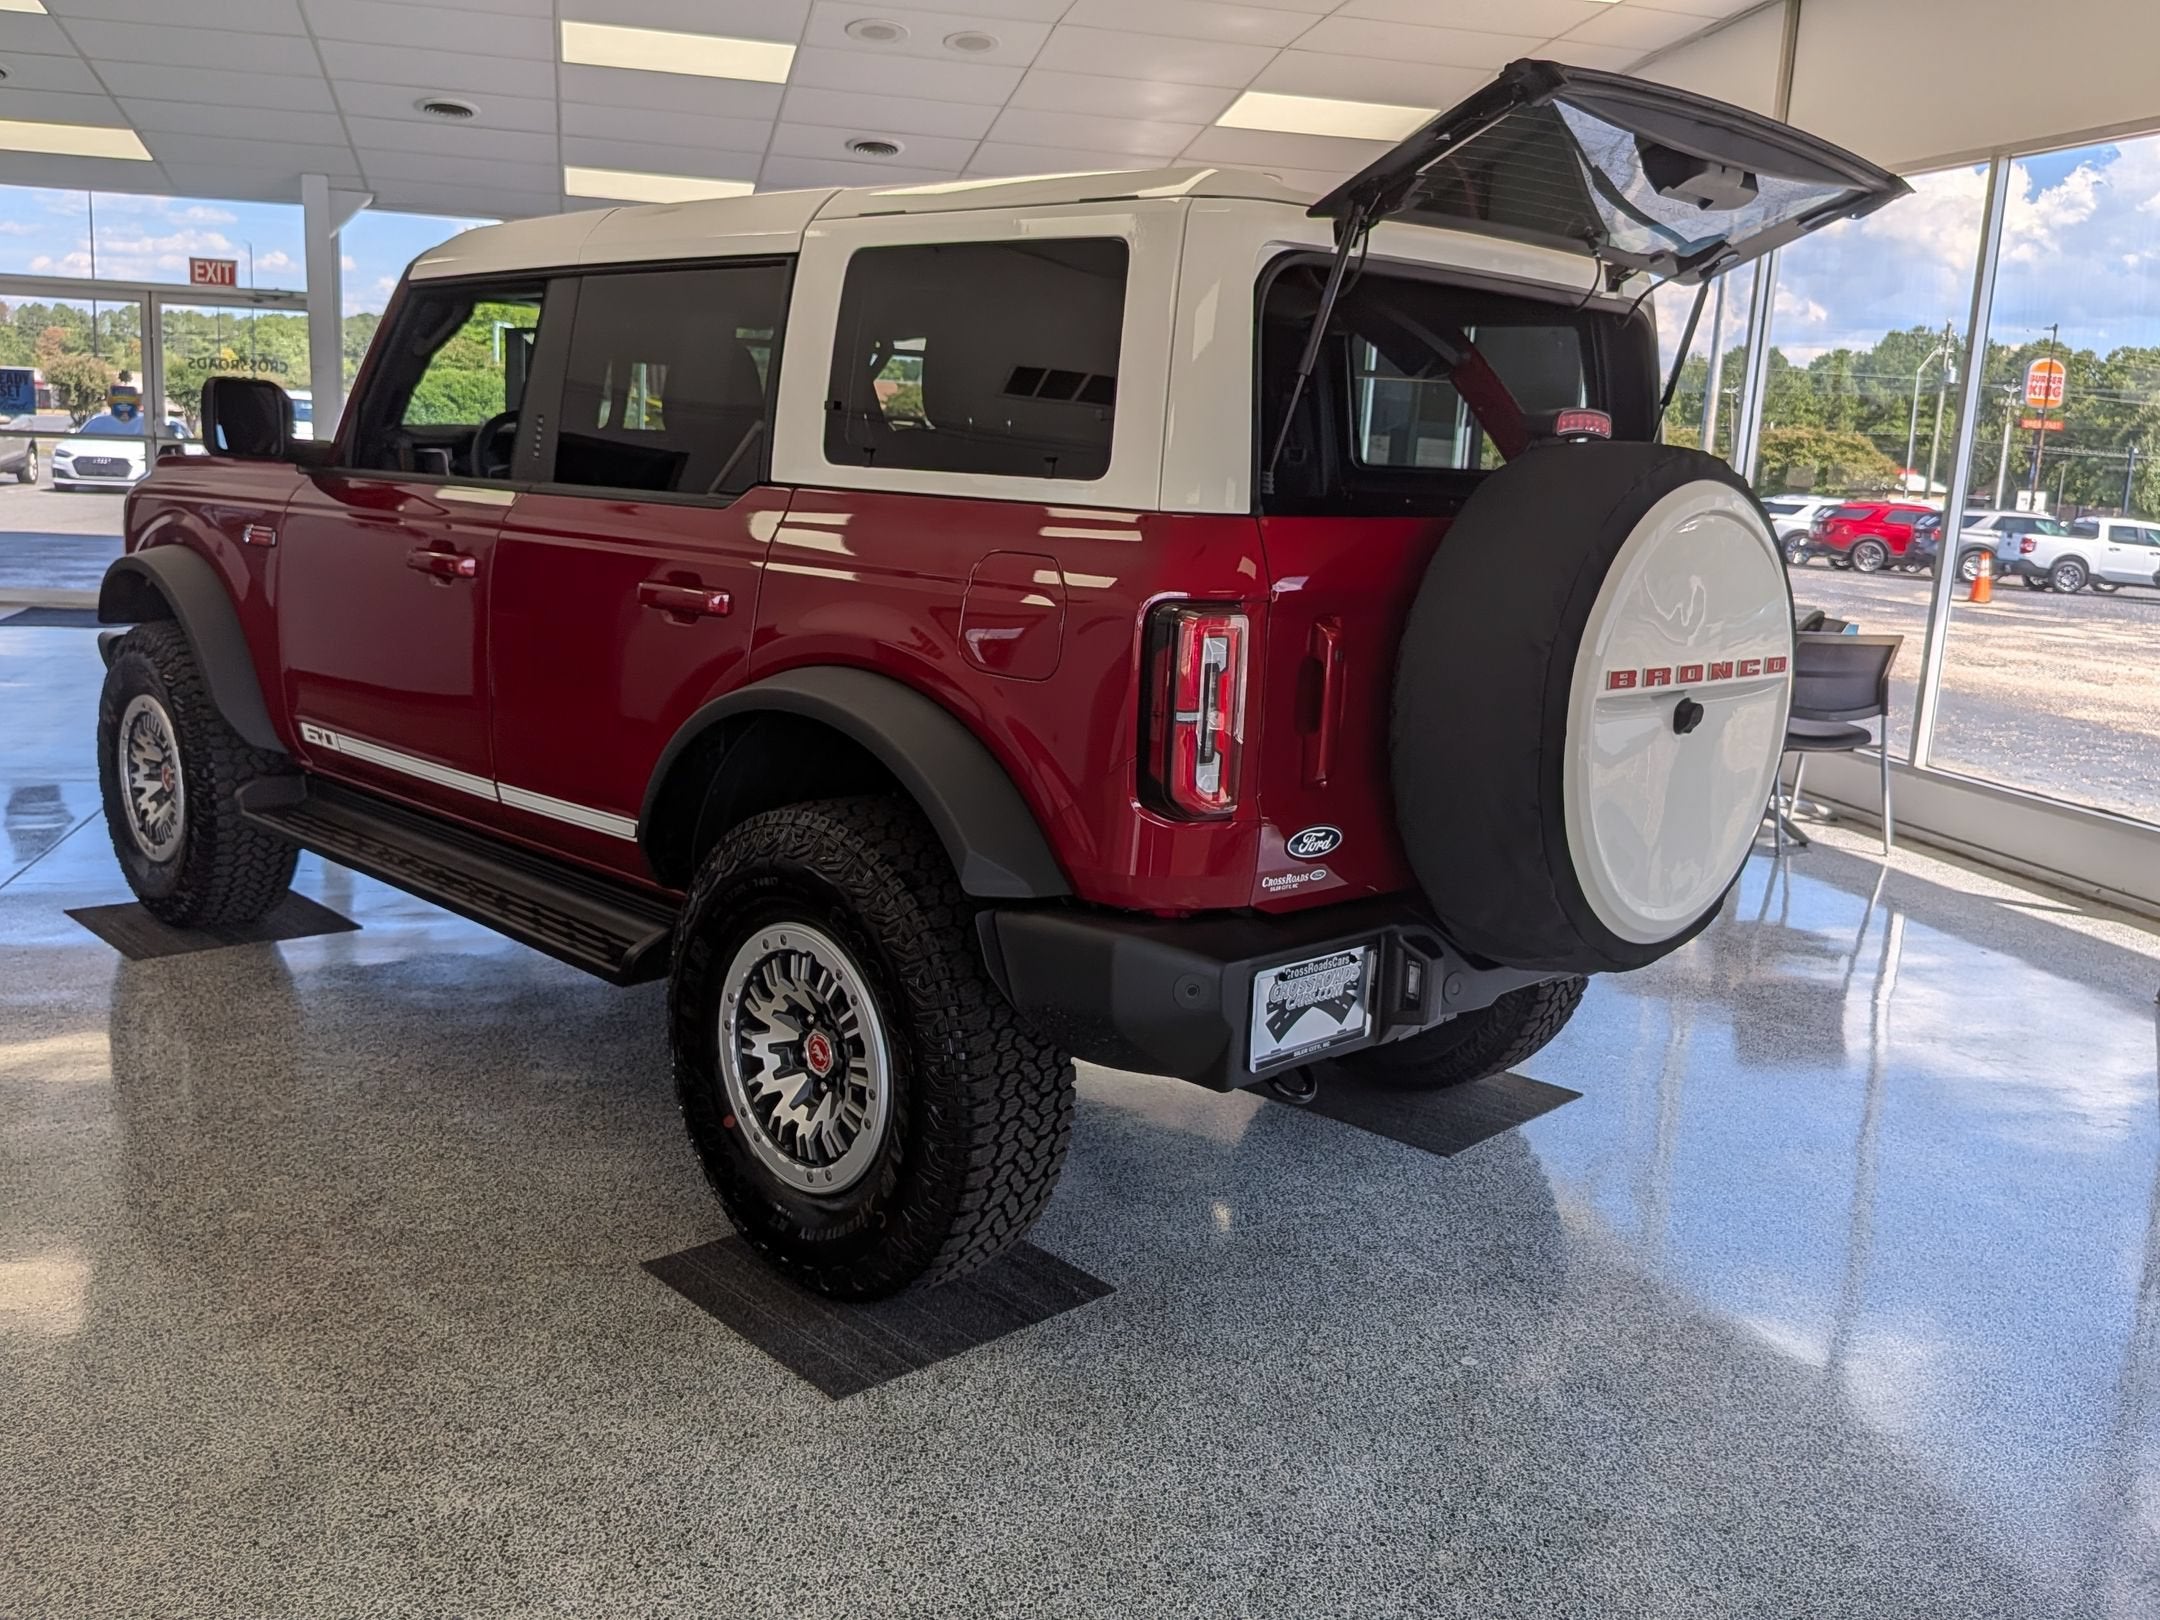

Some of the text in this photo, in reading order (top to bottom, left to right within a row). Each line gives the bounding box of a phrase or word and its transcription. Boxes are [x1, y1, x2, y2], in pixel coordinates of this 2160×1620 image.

[194, 261, 233, 284] EXIT
[0, 372, 31, 385] EADY
[1606, 656, 1787, 691] BRONCO
[1298, 831, 1334, 853] Ford
